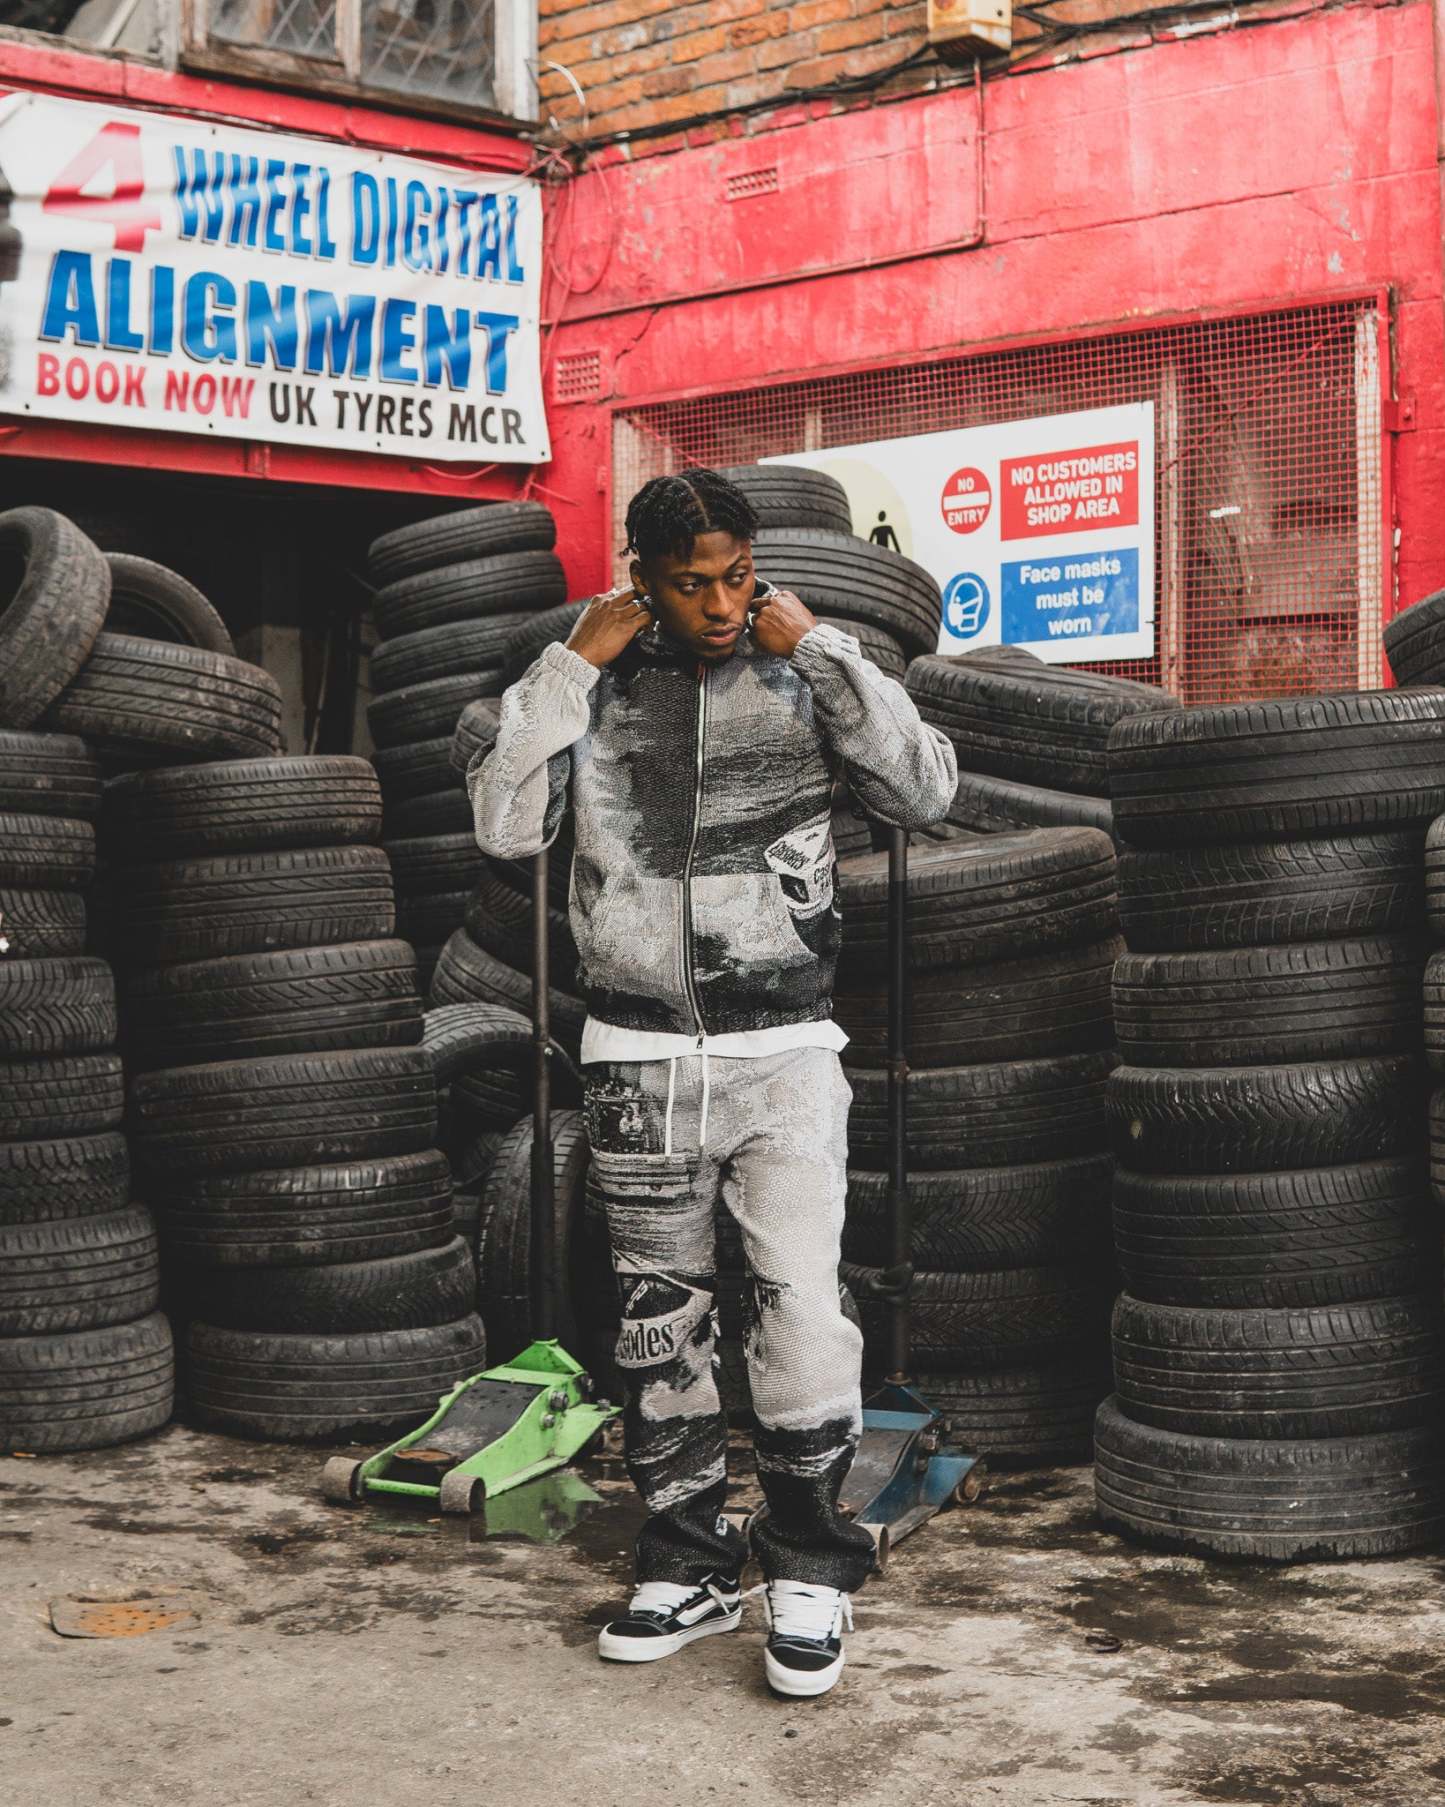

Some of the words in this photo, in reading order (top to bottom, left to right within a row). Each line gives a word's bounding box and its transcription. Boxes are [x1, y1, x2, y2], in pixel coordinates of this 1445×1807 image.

[42, 121, 162, 253] 4
[173, 145, 337, 262] WHEEL
[349, 170, 525, 285] DIGITAL
[37, 249, 520, 395] ALIGNMENT
[36, 353, 146, 408] BOOK
[164, 370, 256, 419] NOW
[269, 381, 317, 427] UK
[333, 389, 434, 439] TYRES
[447, 402, 527, 445] MCR
[1011, 466, 1034, 485] NO
[1037, 451, 1137, 480] CUSTOMERS
[957, 476, 974, 491] NO
[1024, 478, 1100, 505] ALLOWED
[1105, 474, 1123, 495] IN
[947, 509, 985, 525] ENTRY
[1027, 504, 1071, 526] SHOP
[1075, 497, 1120, 519] AREA
[1020, 564, 1060, 584] Face
[1064, 556, 1121, 580] masks
[1036, 588, 1078, 610] must
[1083, 585, 1104, 605] be
[1048, 618, 1092, 635] worn
